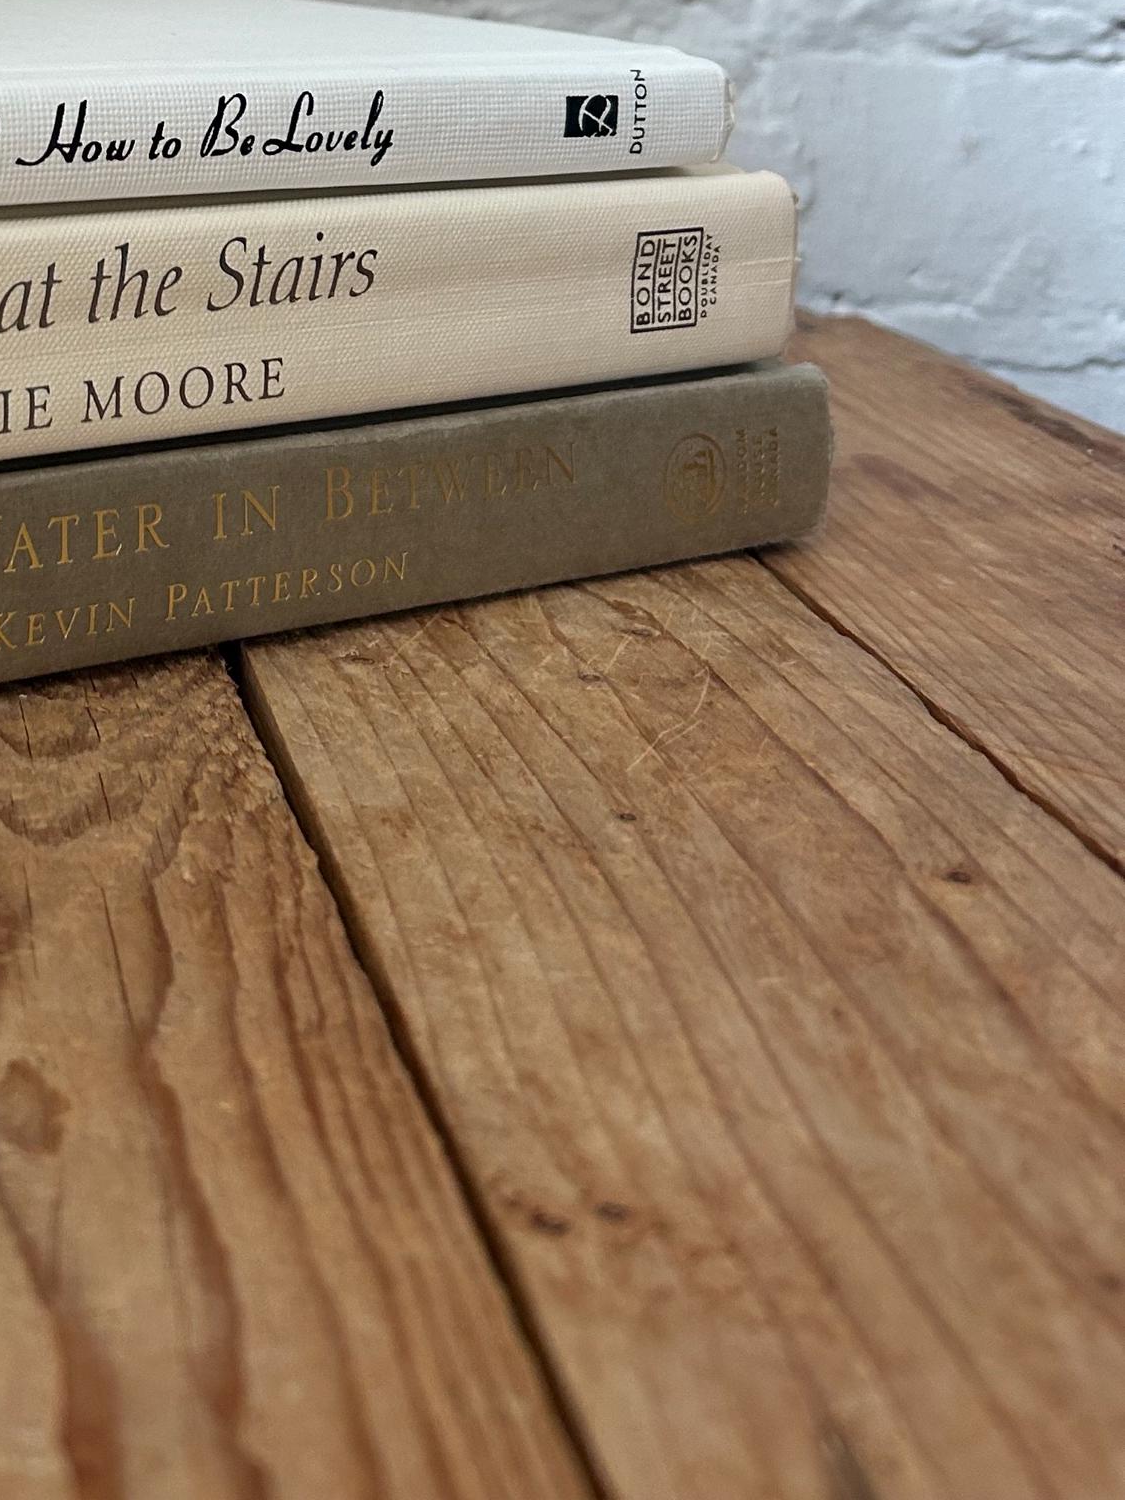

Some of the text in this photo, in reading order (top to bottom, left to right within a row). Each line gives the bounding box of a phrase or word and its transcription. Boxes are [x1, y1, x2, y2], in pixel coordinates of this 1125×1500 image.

[15, 90, 394, 167] How to Be Lovely
[629, 69, 647, 154] DUTTON
[87, 243, 184, 324] the
[206, 231, 380, 313] Stairs
[636, 239, 655, 325] BOND
[657, 238, 676, 323] STREET
[678, 234, 698, 321] BOOKS
[700, 234, 713, 318] DOUBLEDAY
[709, 244, 721, 305] CANADA
[81, 358, 286, 422] MOORE
[211, 485, 280, 542] IN
[324, 443, 576, 522] BETWEEN
[164, 552, 410, 622] PATTERSON
